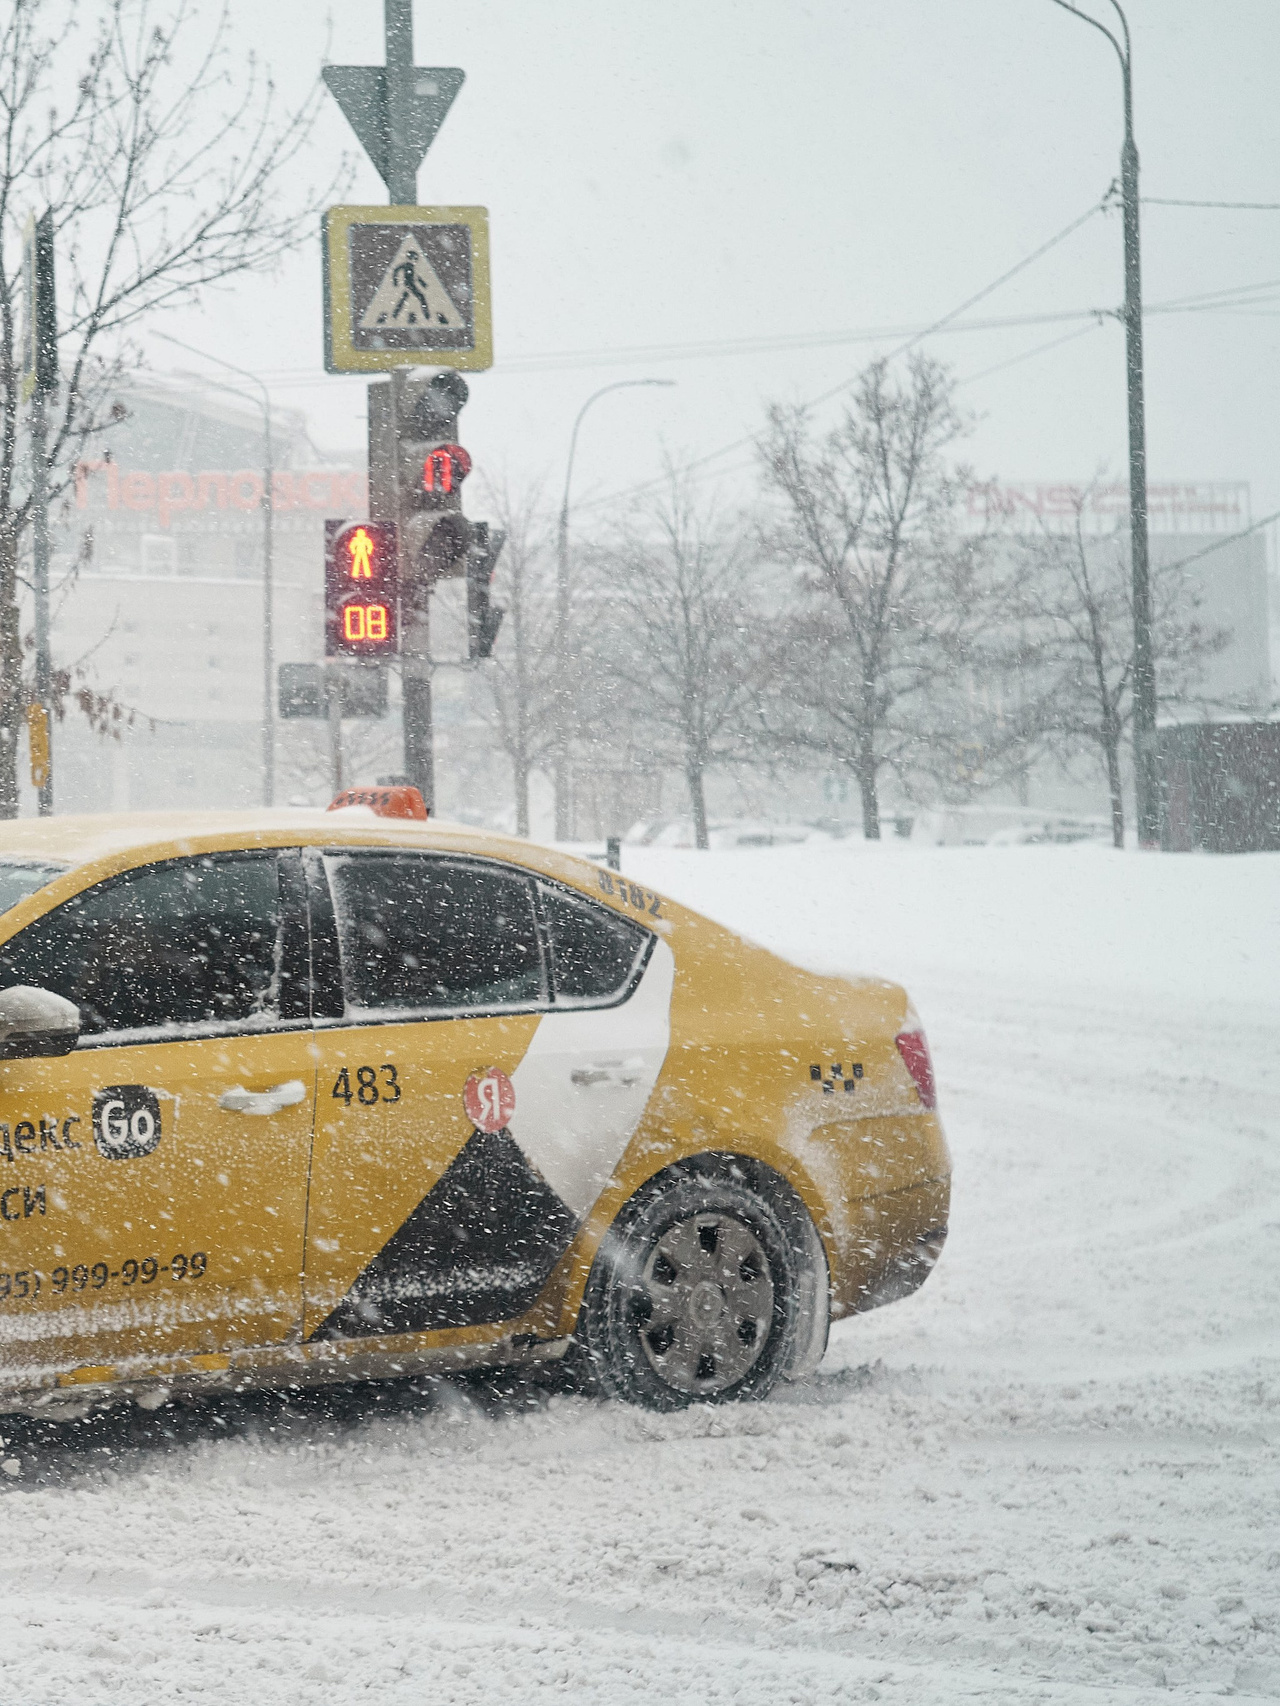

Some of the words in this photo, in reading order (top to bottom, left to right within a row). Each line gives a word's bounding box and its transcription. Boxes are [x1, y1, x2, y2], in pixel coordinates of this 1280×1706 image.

[74, 459, 369, 528] Перловск
[344, 604, 387, 641] 08
[332, 1063, 402, 1107] 483
[100, 1099, 155, 1145] Go
[51, 1252, 208, 1295] 999-99-99
